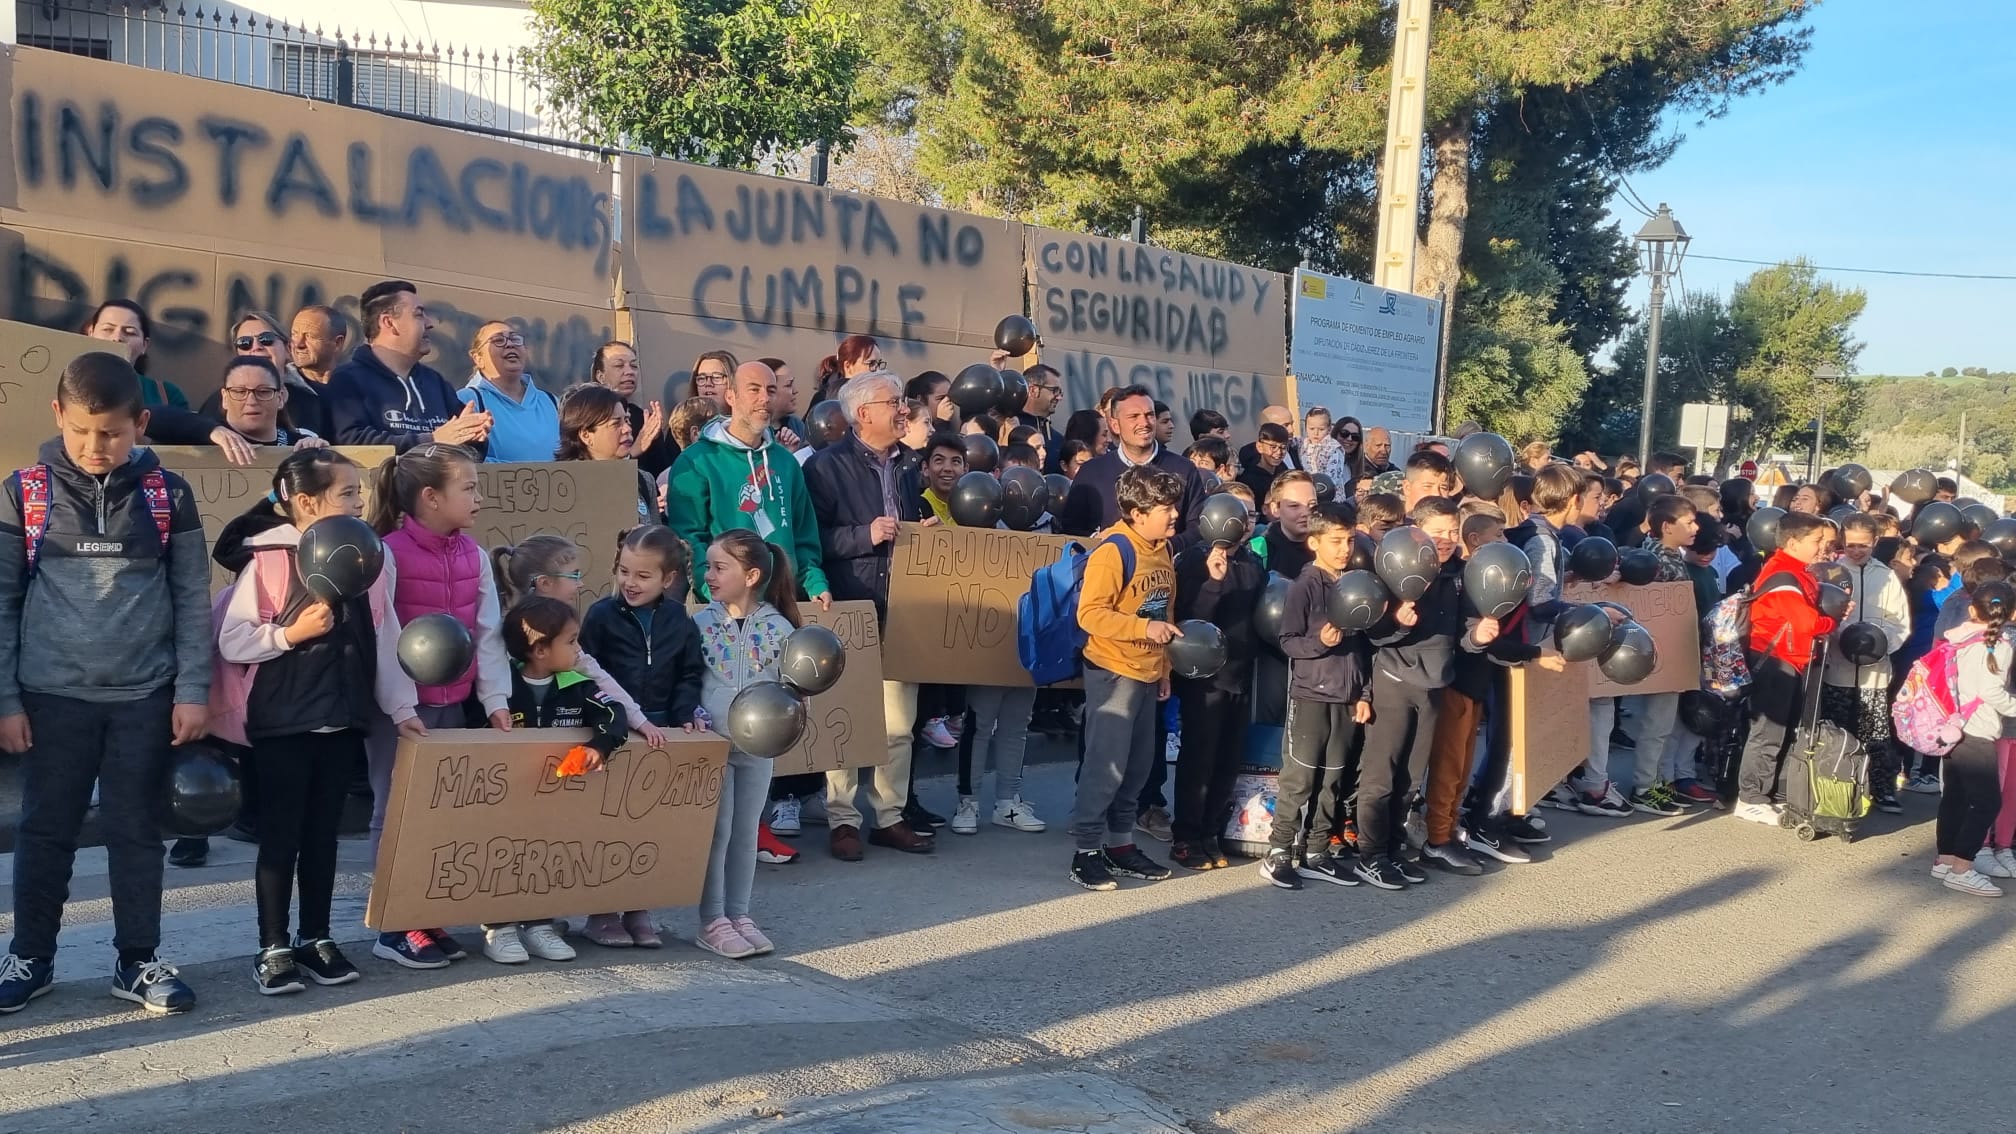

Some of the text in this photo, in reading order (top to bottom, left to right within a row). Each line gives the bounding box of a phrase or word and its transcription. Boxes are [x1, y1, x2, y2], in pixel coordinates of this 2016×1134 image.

[724, 183, 899, 258] JUNTA
[918, 212, 984, 267] NO
[692, 262, 927, 359] CUMPLE
[1041, 239, 1108, 279] CON
[1252, 272, 1271, 314] Y
[1741, 469, 1756, 477] STOP
[77, 541, 123, 553] LEGEND
[832, 609, 877, 650] QUE
[943, 582, 1013, 650] NO
[430, 755, 508, 809] MAS
[535, 755, 587, 797] DE
[600, 749, 672, 820] 10
[425, 835, 660, 901] ESPERANDO
